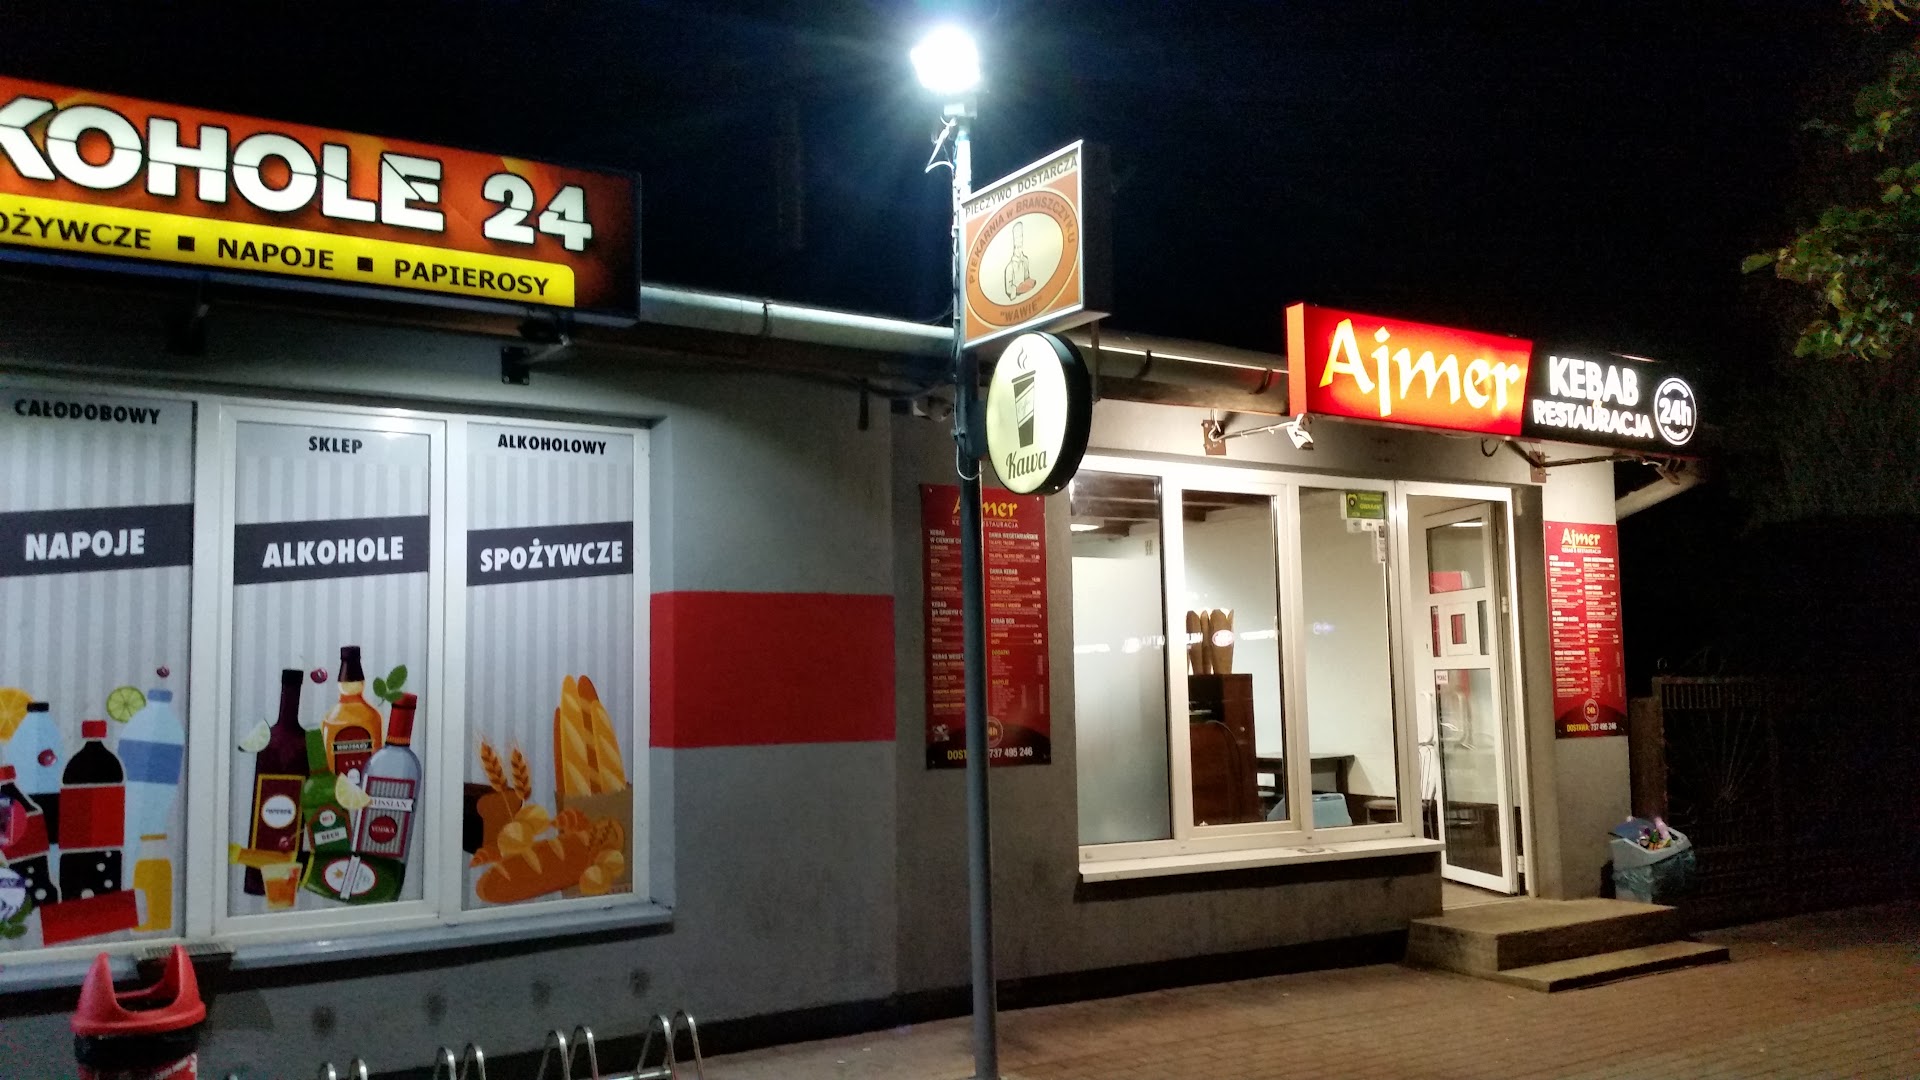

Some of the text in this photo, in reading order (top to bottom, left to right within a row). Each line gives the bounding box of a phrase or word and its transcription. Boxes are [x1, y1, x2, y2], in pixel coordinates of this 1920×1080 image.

[964, 156, 1078, 218] PIECZYWO DOSTARCZA
[483, 173, 592, 251] 24
[218, 237, 334, 270] NAPOJE
[395, 258, 550, 296] PAPIEROSY
[968, 215, 1005, 285] PIEKARNIA
[1319, 318, 1521, 418] Ajmer
[1549, 356, 1639, 407] KEBAB
[15, 399, 161, 425] CAŁODOBOWY
[1532, 399, 1655, 439] RESTAURACJA
[1658, 397, 1692, 427] 24h
[308, 436, 363, 454] SKLEP
[497, 433, 607, 456] ALKOHOLOWY
[1006, 450, 1048, 480] Kawa
[25, 528, 146, 561] NAPOJE
[262, 536, 404, 569] ALKOHOLE
[1561, 528, 1601, 547] Ajmer
[480, 538, 623, 573] SPOŻYWCZE
